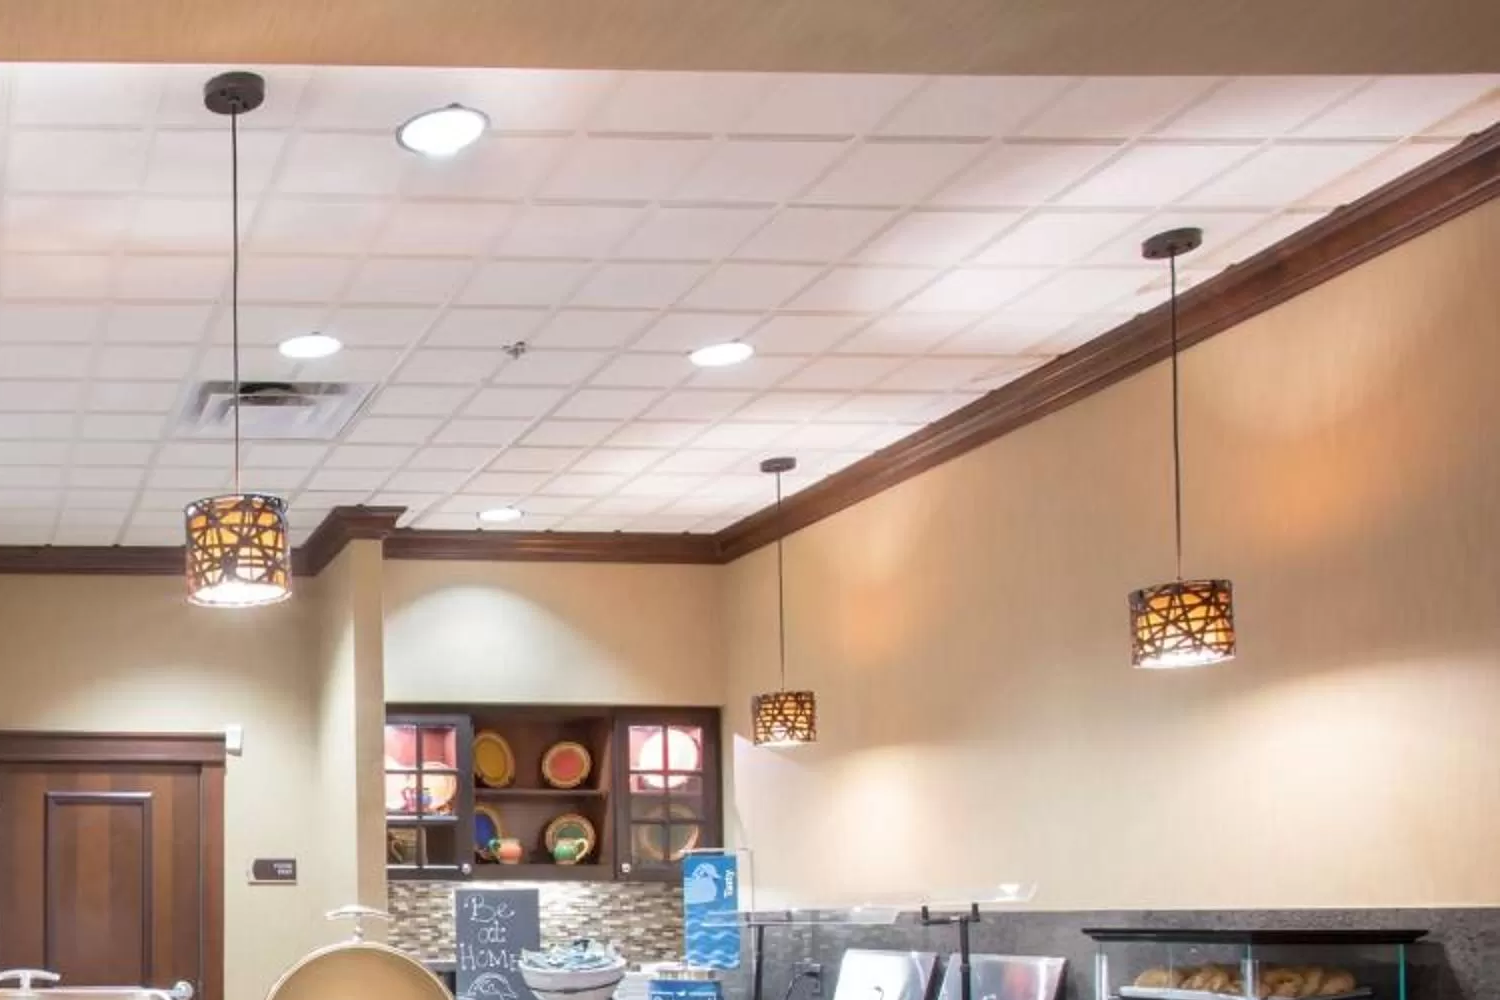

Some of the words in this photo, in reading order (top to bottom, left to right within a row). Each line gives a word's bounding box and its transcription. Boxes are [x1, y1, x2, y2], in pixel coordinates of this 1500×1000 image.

[724, 869, 735, 899] Tasty
[463, 893, 515, 923] Be
[459, 942, 519, 972] HOME
